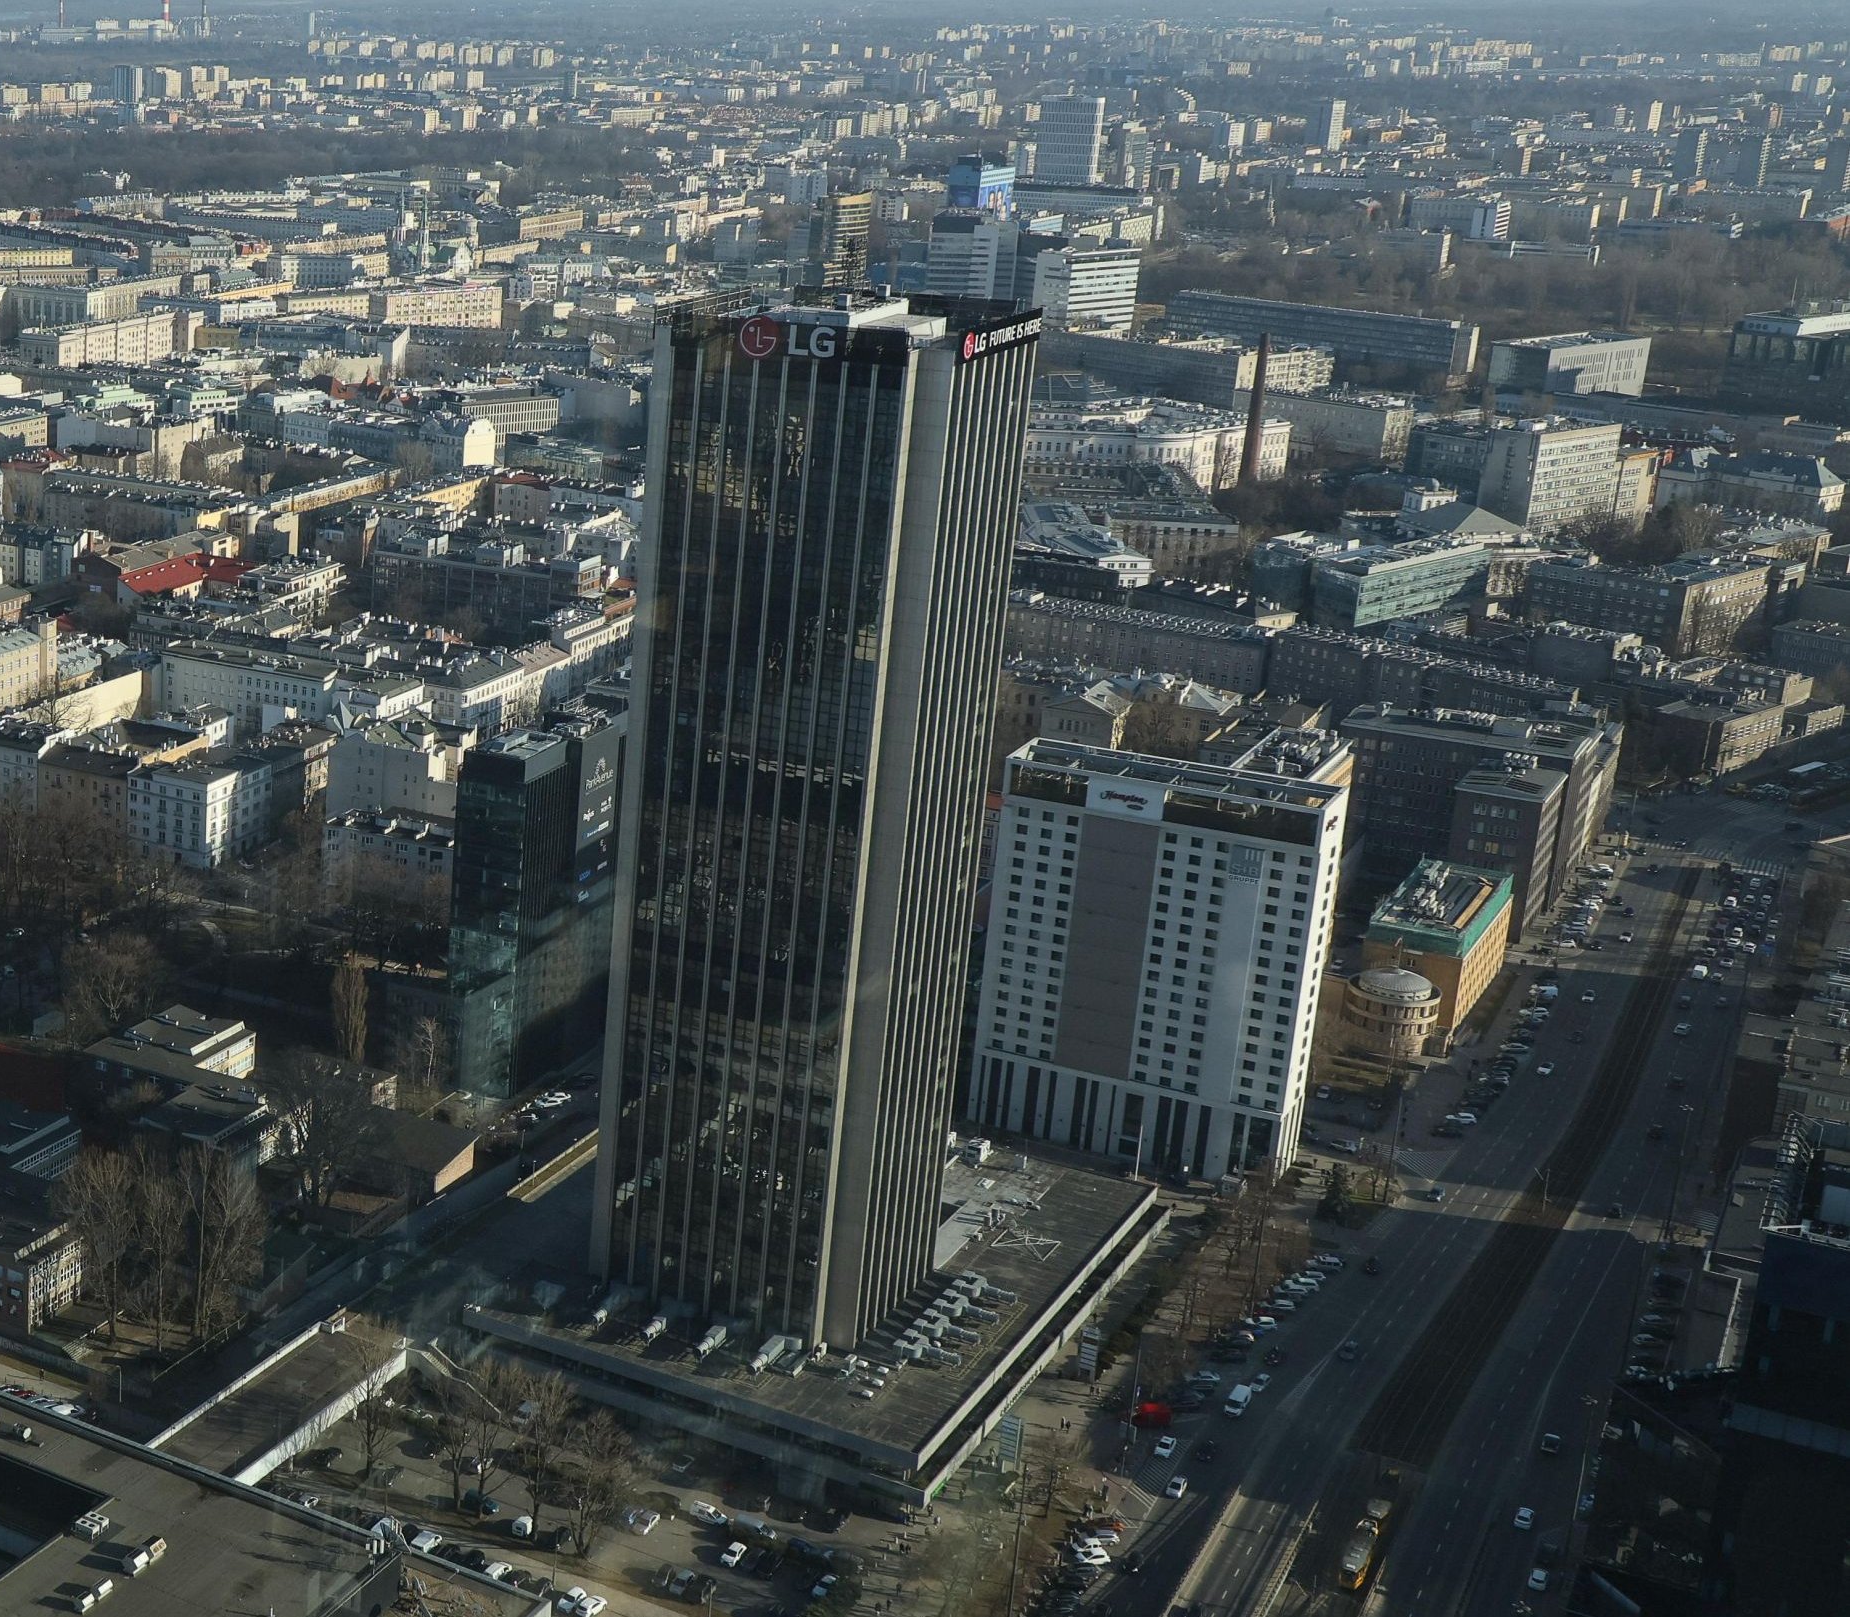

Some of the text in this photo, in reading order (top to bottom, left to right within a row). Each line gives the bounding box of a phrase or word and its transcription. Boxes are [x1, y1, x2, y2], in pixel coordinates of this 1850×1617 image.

[788, 324, 836, 358] LG
[974, 317, 1042, 353] LG FUTURE IS HERE
[1228, 874, 1260, 885] GRUPPE
